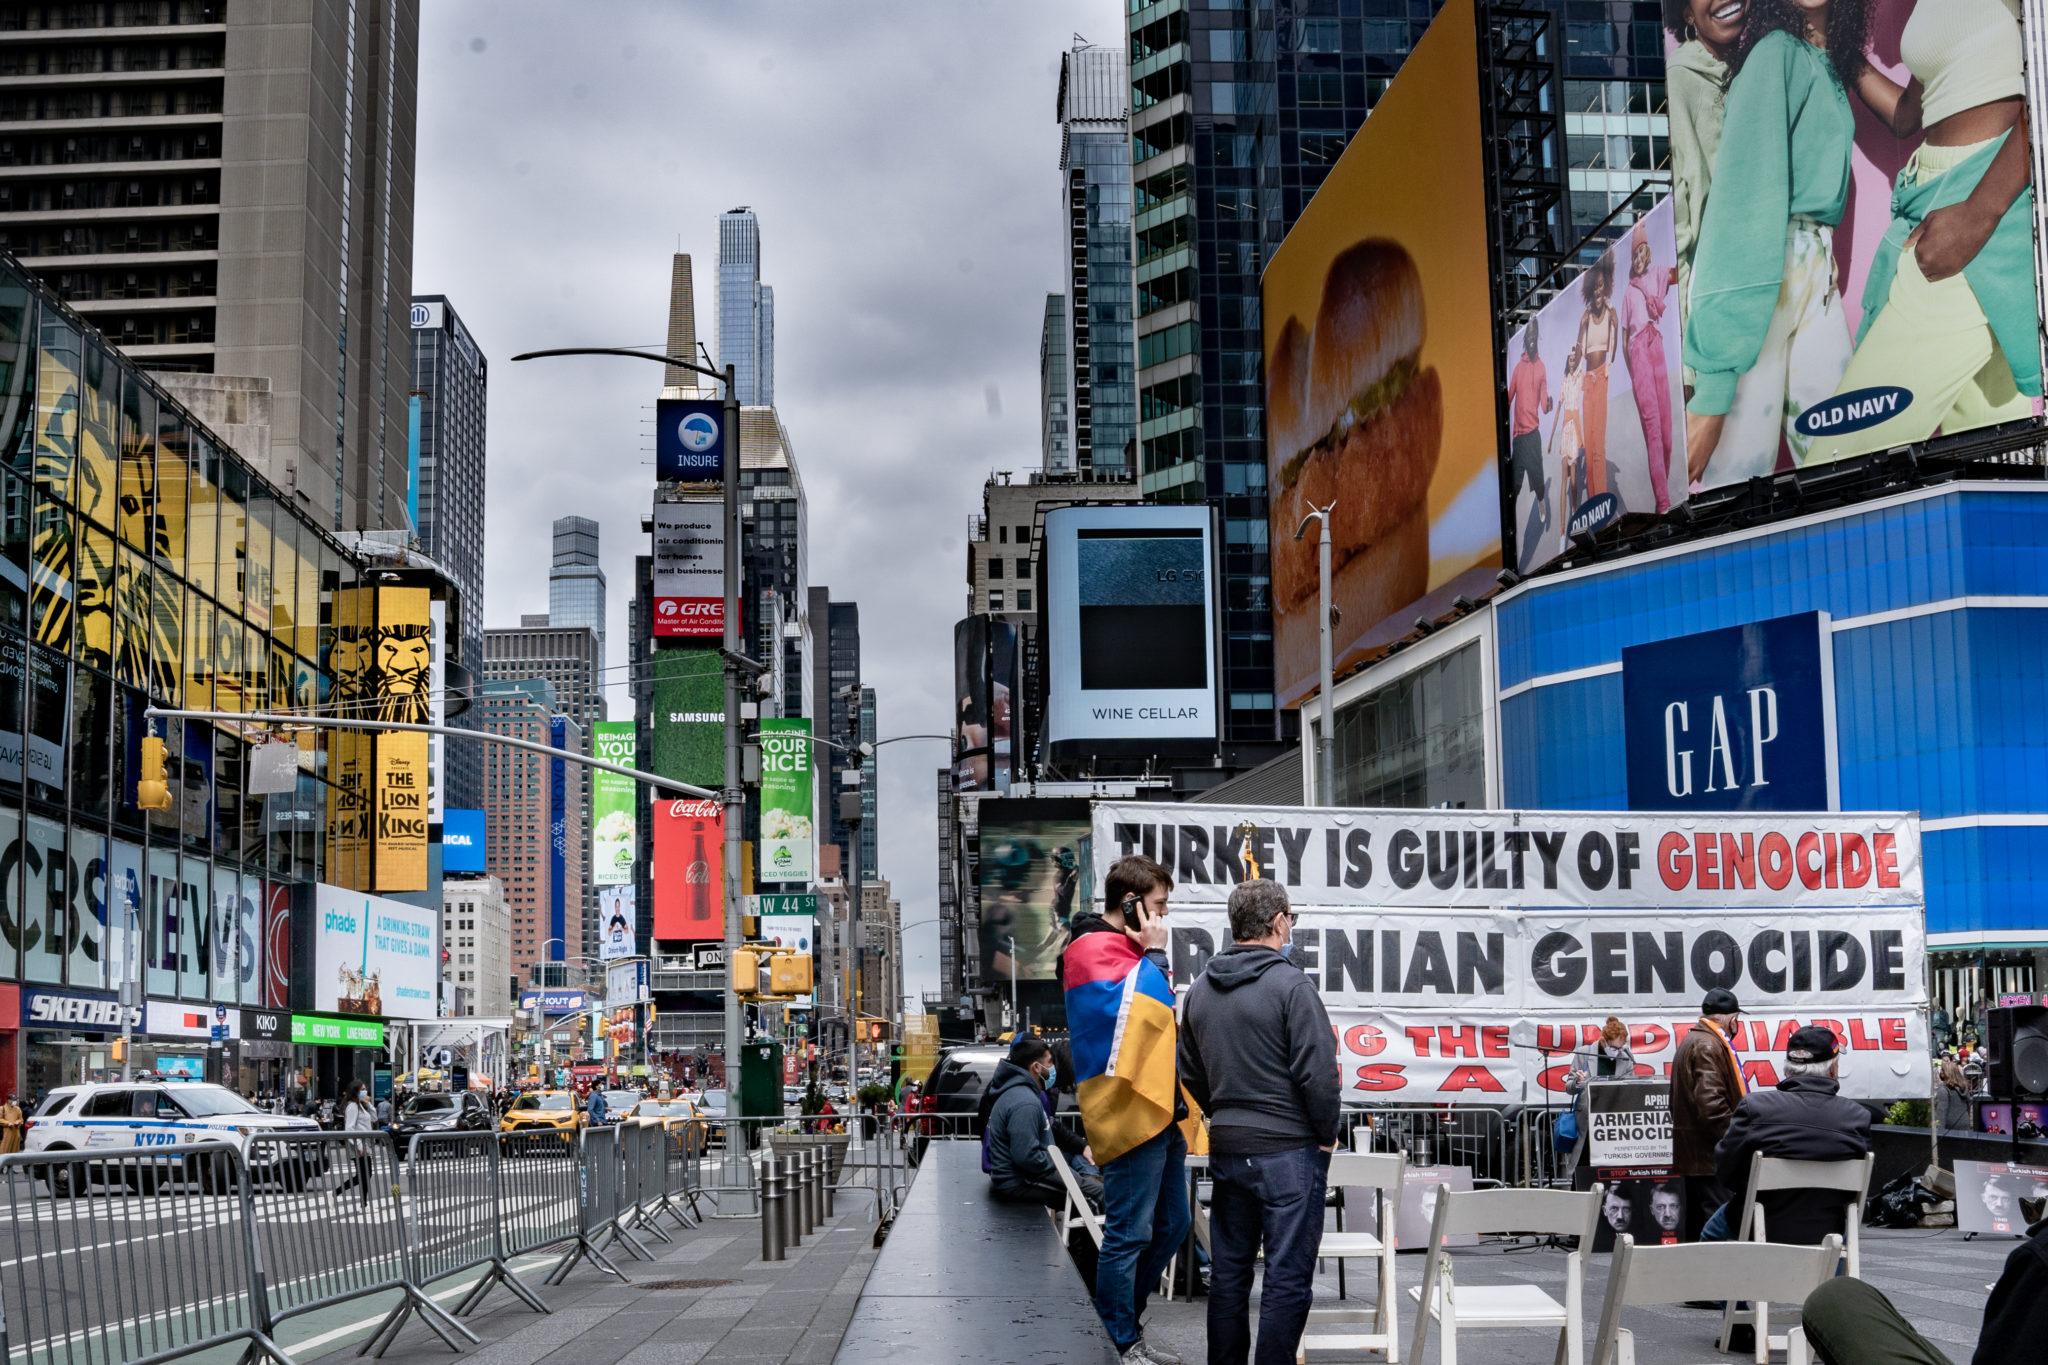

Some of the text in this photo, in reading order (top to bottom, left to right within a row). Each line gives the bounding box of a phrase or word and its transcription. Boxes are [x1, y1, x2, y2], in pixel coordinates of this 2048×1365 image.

[1808, 392, 1898, 430] OLD NAVY
[677, 454, 718, 467] INSURE
[1572, 498, 1610, 530] OLD NAVY
[674, 522, 711, 531] produce
[1156, 570, 1176, 582] LG
[681, 603, 724, 615] GRE
[670, 712, 725, 723] SAMSUNG
[1092, 708, 1198, 719] WINE CELLAR
[599, 742, 635, 756] YOU
[1666, 688, 1778, 798] GAP
[551, 727, 565, 811] NOVOEL
[386, 772, 413, 785] THE
[382, 788, 419, 810] LION
[379, 812, 425, 839] KING
[443, 835, 472, 845] ICAL
[1114, 822, 1900, 891] TURKEY IS GUILTY OF GENOCIDE
[0, 838, 255, 984] CBS NEWS
[763, 896, 814, 913] W 44 St
[325, 909, 356, 934] phade
[377, 916, 430, 939] A DRINKING STRAW
[375, 935, 389, 950] THAT
[391, 938, 407, 954] GIVES
[409, 942, 413, 955] A
[706, 952, 725, 963] ON
[1172, 928, 1905, 996] RENIAN GENOCIDE
[256, 1015, 277, 1030] KIKO
[312, 1024, 326, 1037] NEW
[326, 1024, 340, 1038] YORK
[347, 1026, 358, 1039] LINE
[358, 1027, 377, 1040] FRIENDS
[1405, 1026, 1510, 1058] THE
[1437, 1065, 1507, 1092] A
[1594, 1113, 1673, 1126] ARMENIA
[135, 1133, 176, 1146] NYPD
[1594, 1128, 1673, 1141] GENOCID
